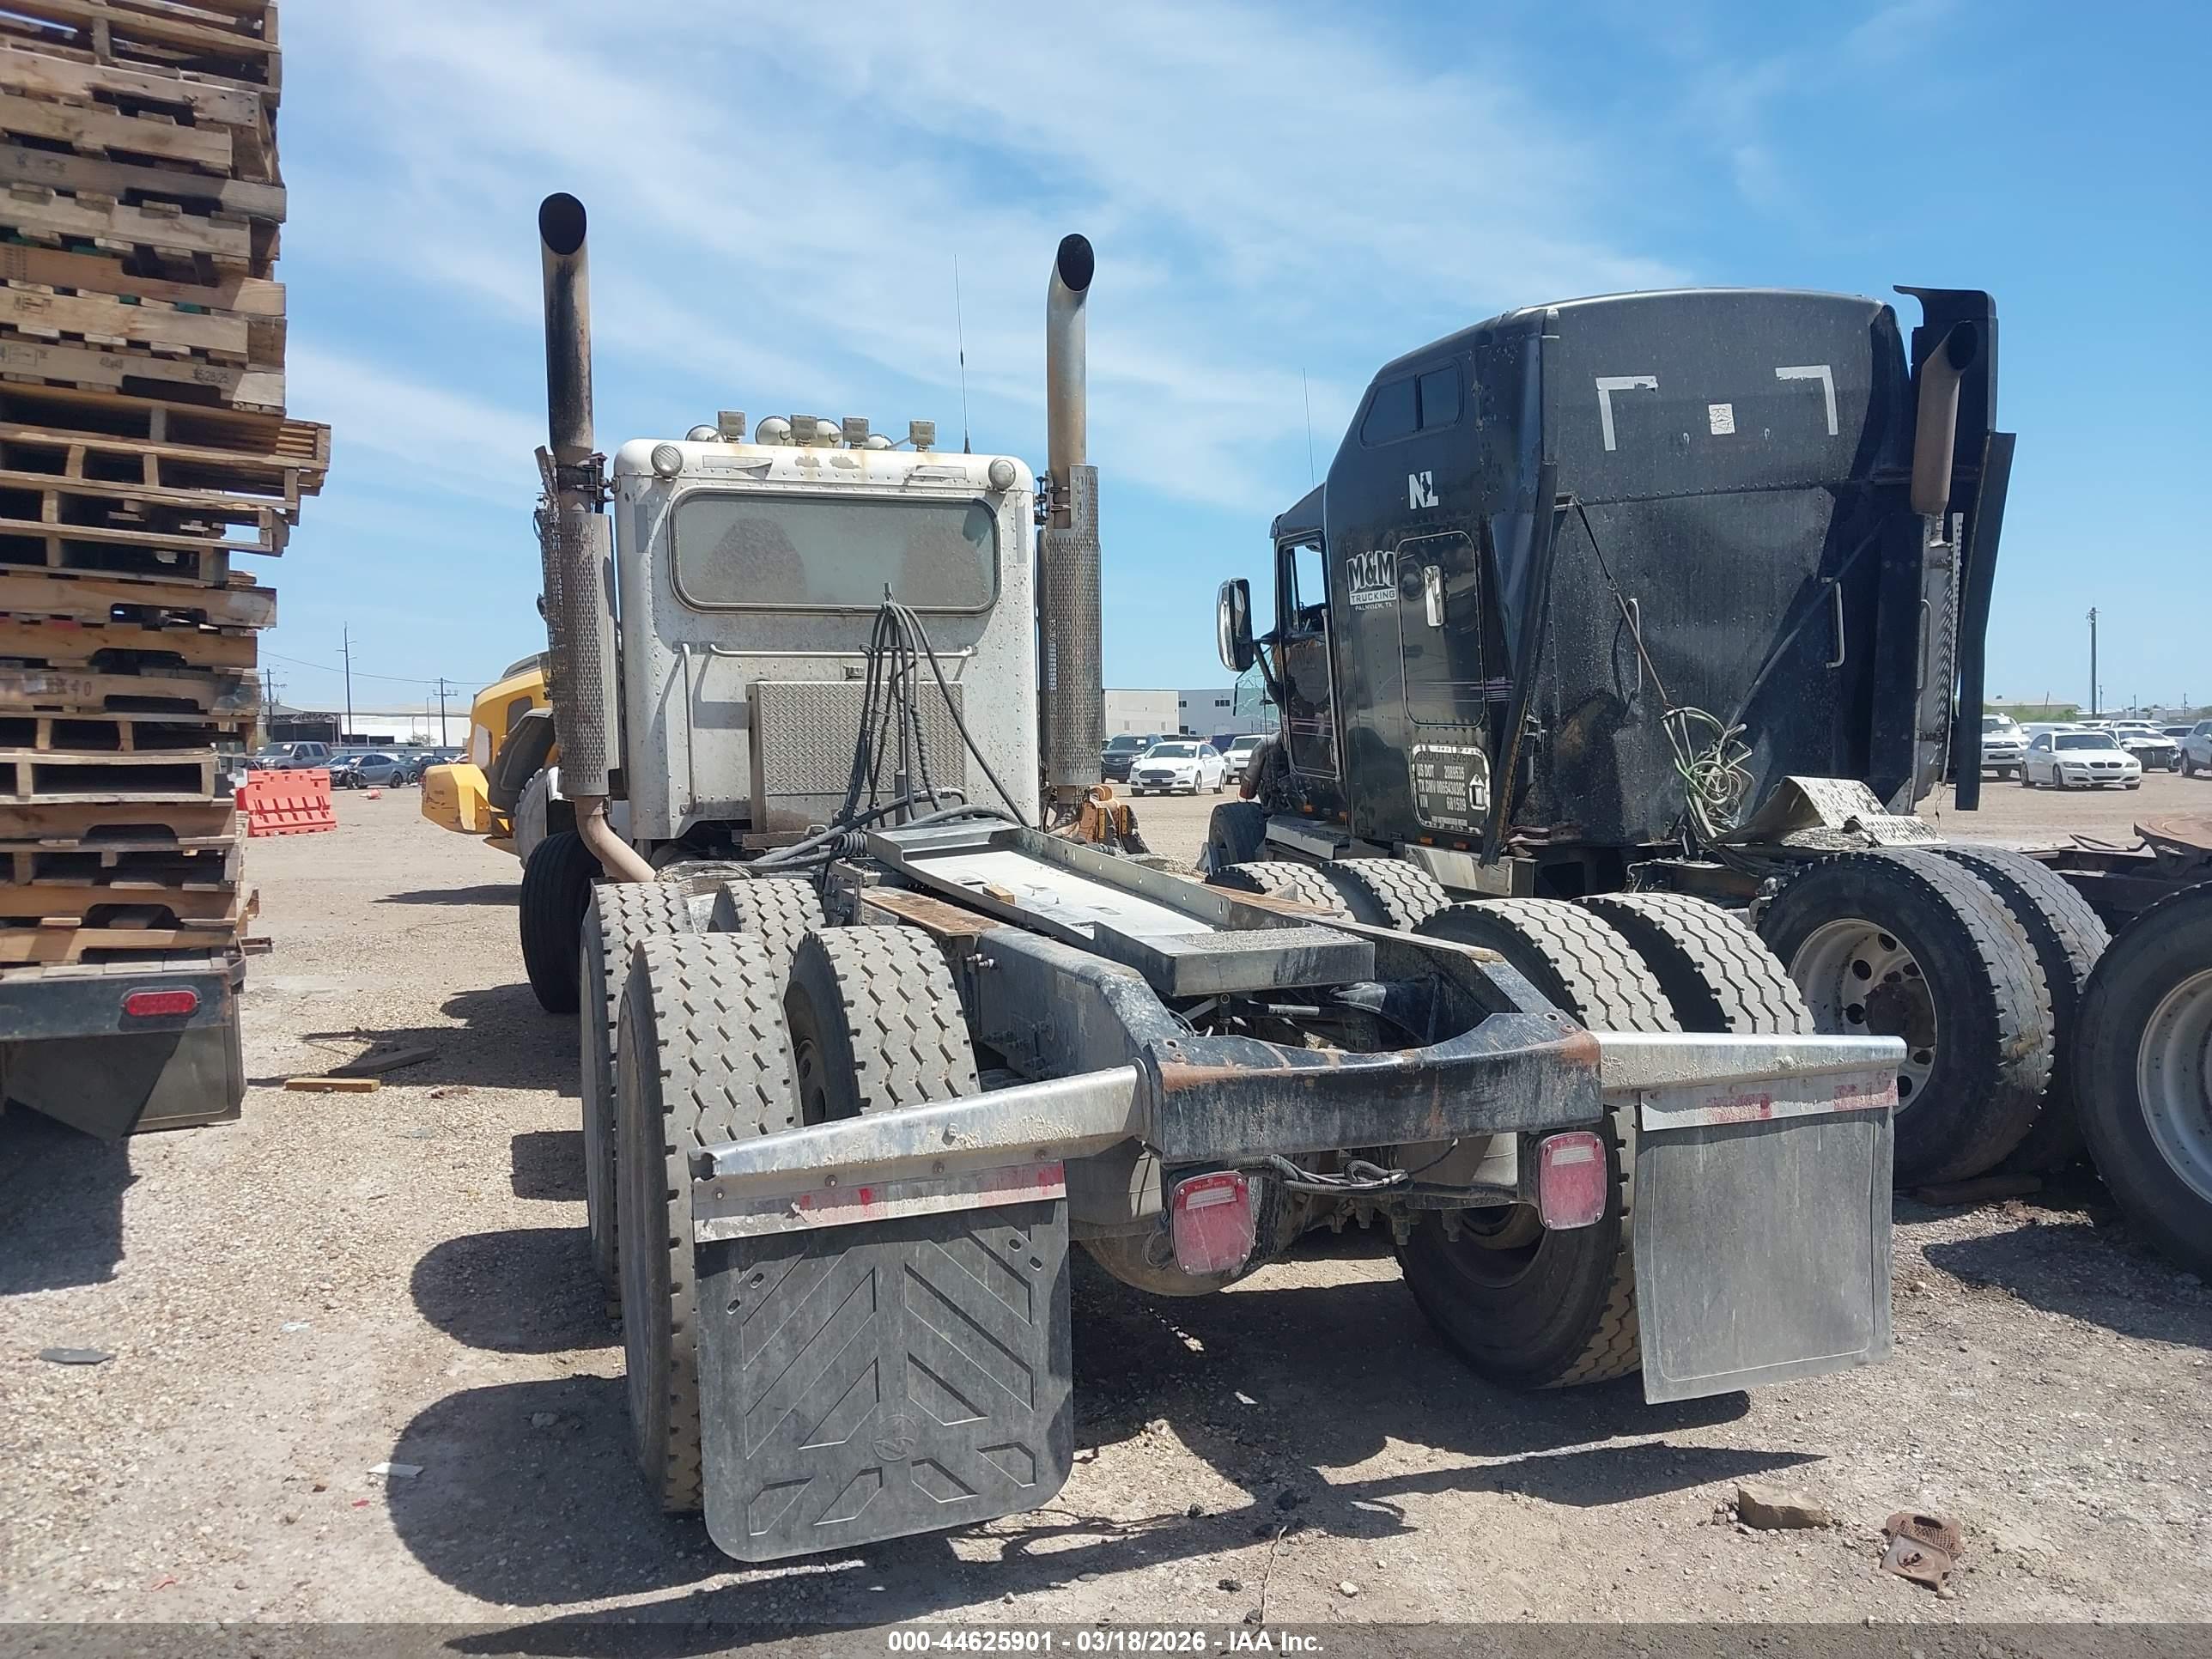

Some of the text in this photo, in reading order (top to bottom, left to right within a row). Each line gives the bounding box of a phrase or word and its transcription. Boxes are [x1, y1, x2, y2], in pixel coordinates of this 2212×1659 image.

[1346, 550, 1395, 593] M&M
[1351, 590, 1395, 603] TRUCKING
[1416, 763, 1424, 777] US
[1425, 763, 1434, 778] DOT
[1417, 779, 1425, 792] TX
[1419, 794, 1429, 808] VIN
